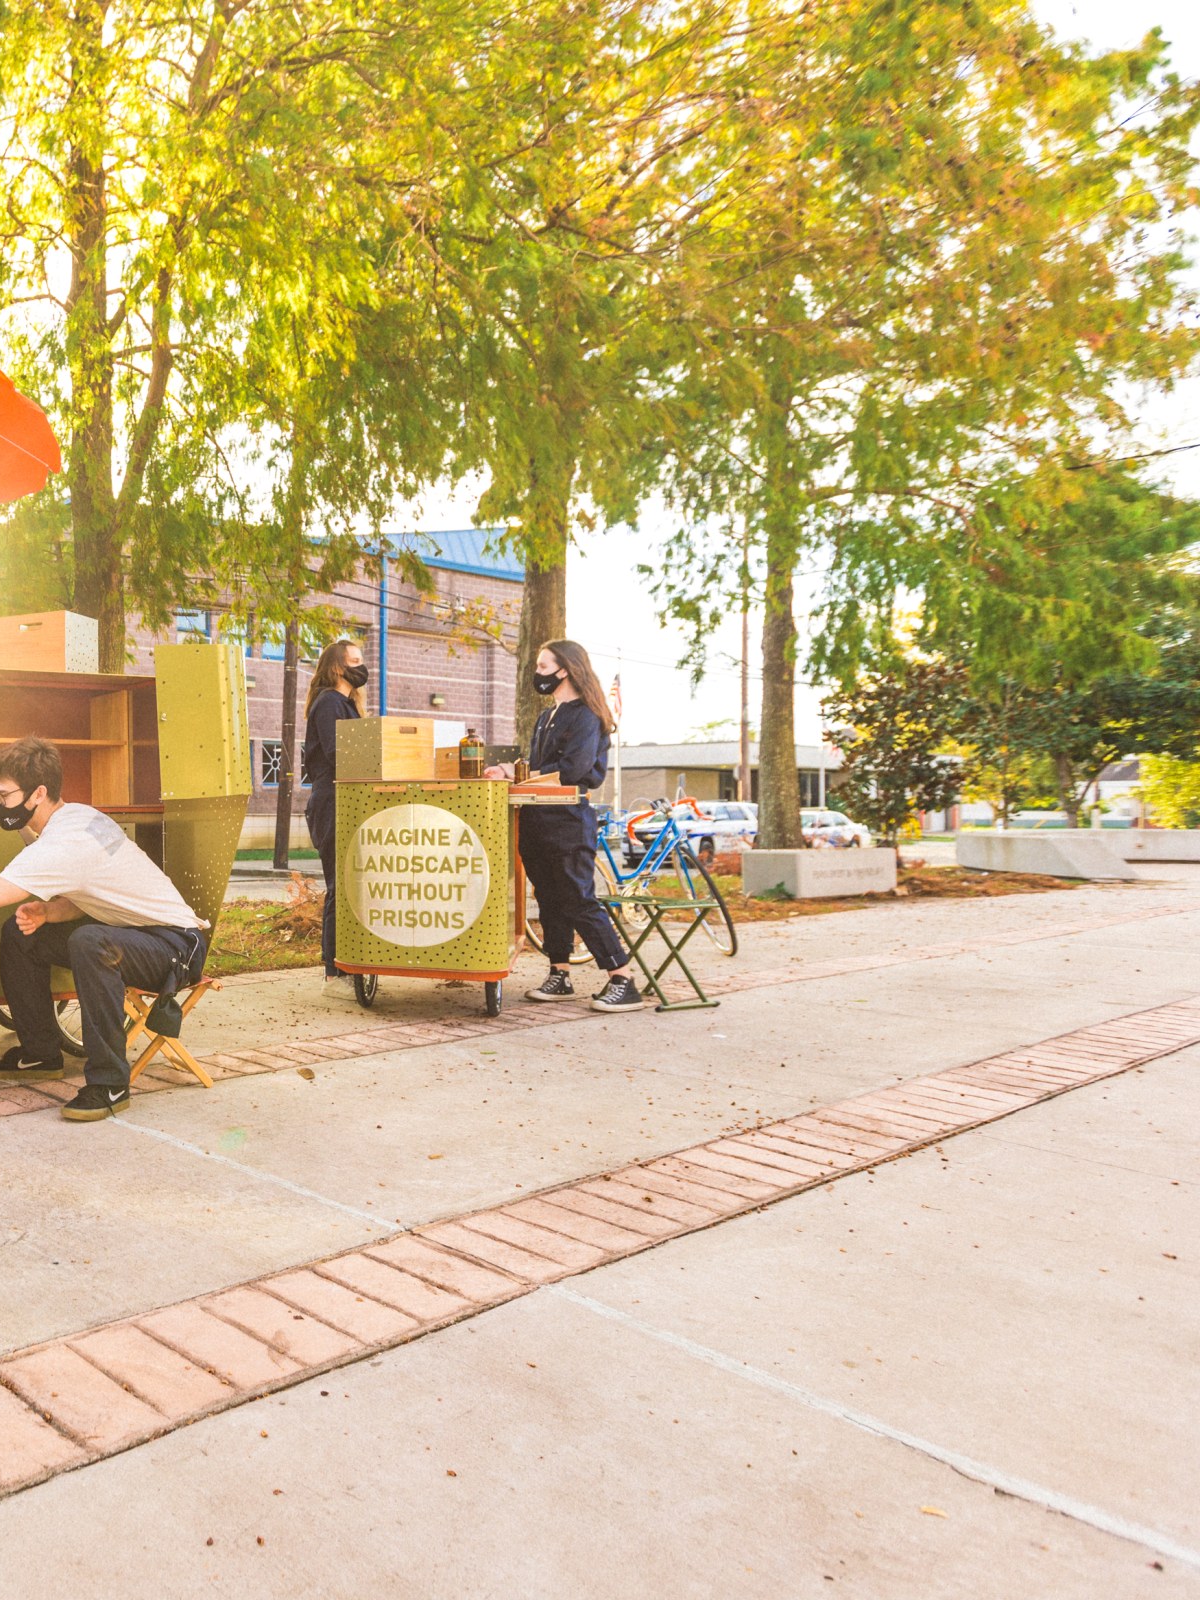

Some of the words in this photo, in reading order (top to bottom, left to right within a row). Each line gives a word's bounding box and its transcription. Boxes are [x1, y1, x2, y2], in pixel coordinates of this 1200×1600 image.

[360, 828, 450, 846] IMAGINE
[458, 828, 473, 846] A
[352, 855, 483, 874] LANDSCAPE
[367, 882, 466, 901] WITHOUT
[368, 909, 465, 929] PRISONS
